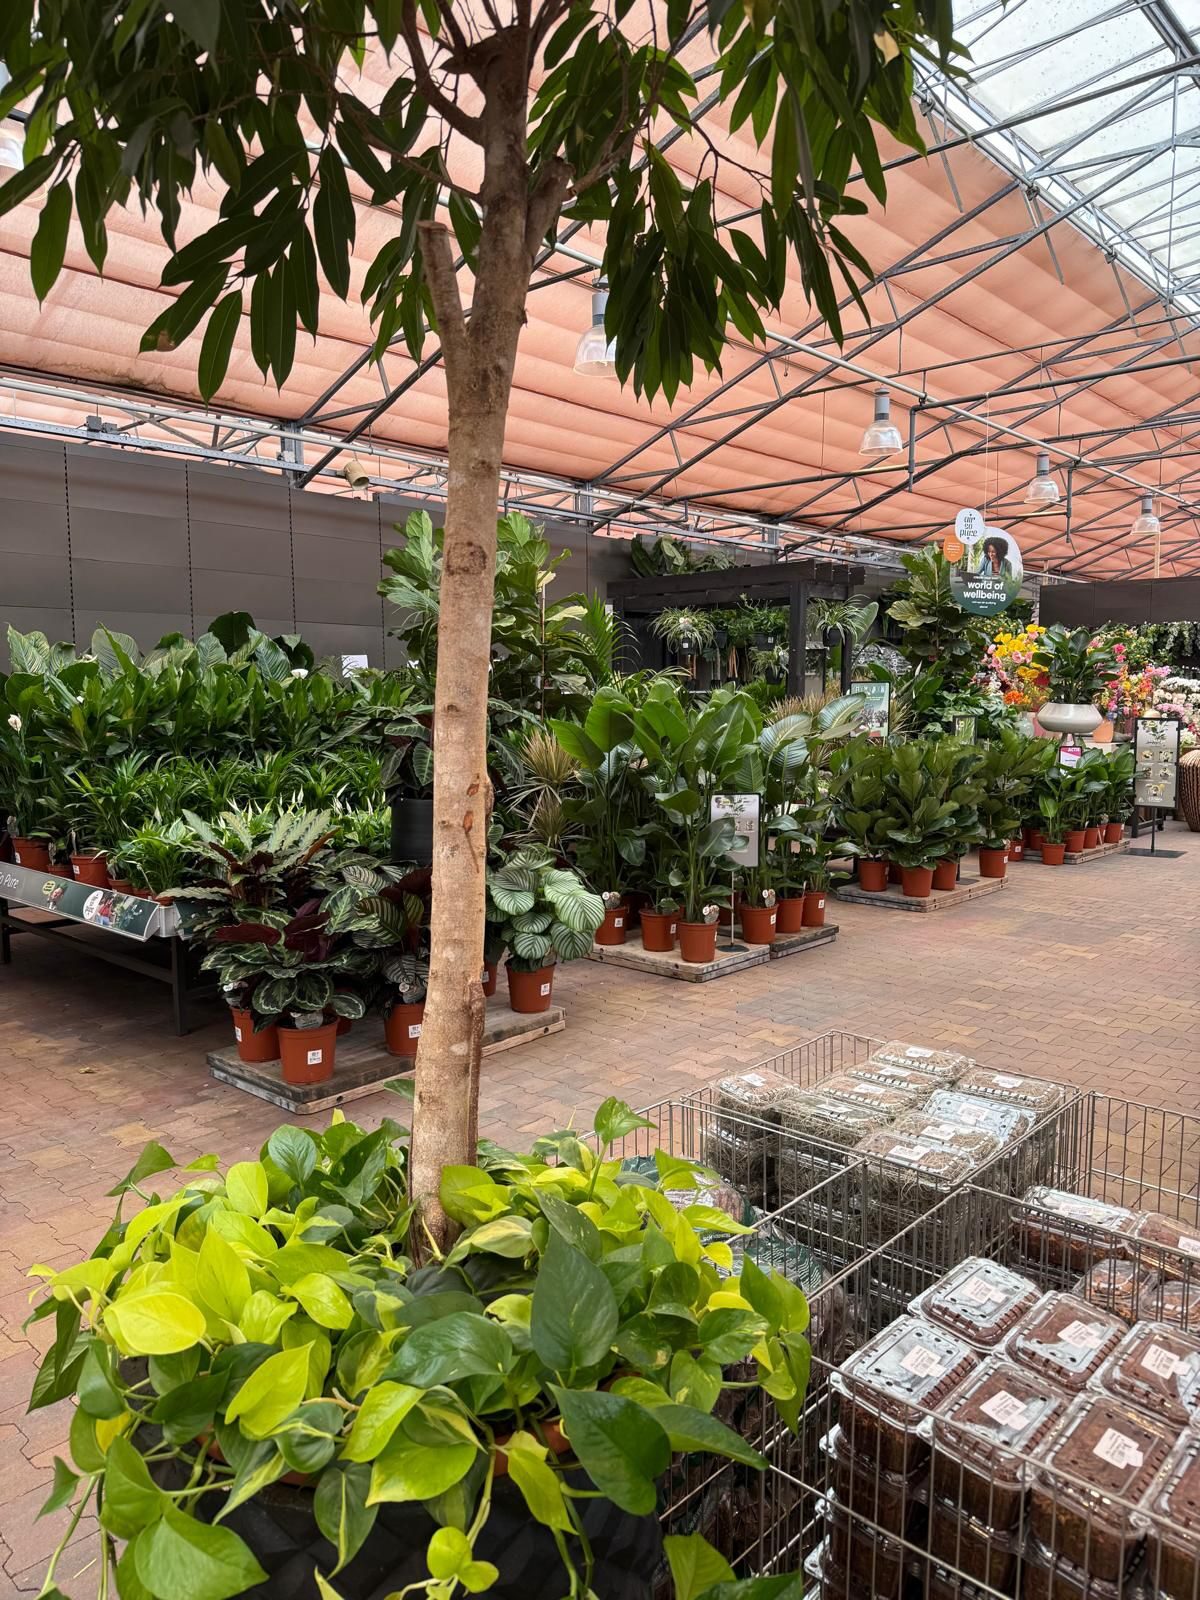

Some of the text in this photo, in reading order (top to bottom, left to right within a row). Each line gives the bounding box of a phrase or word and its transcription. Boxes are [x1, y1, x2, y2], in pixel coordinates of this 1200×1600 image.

[967, 580, 1004, 590] world of
[963, 591, 1006, 601] wellbeing
